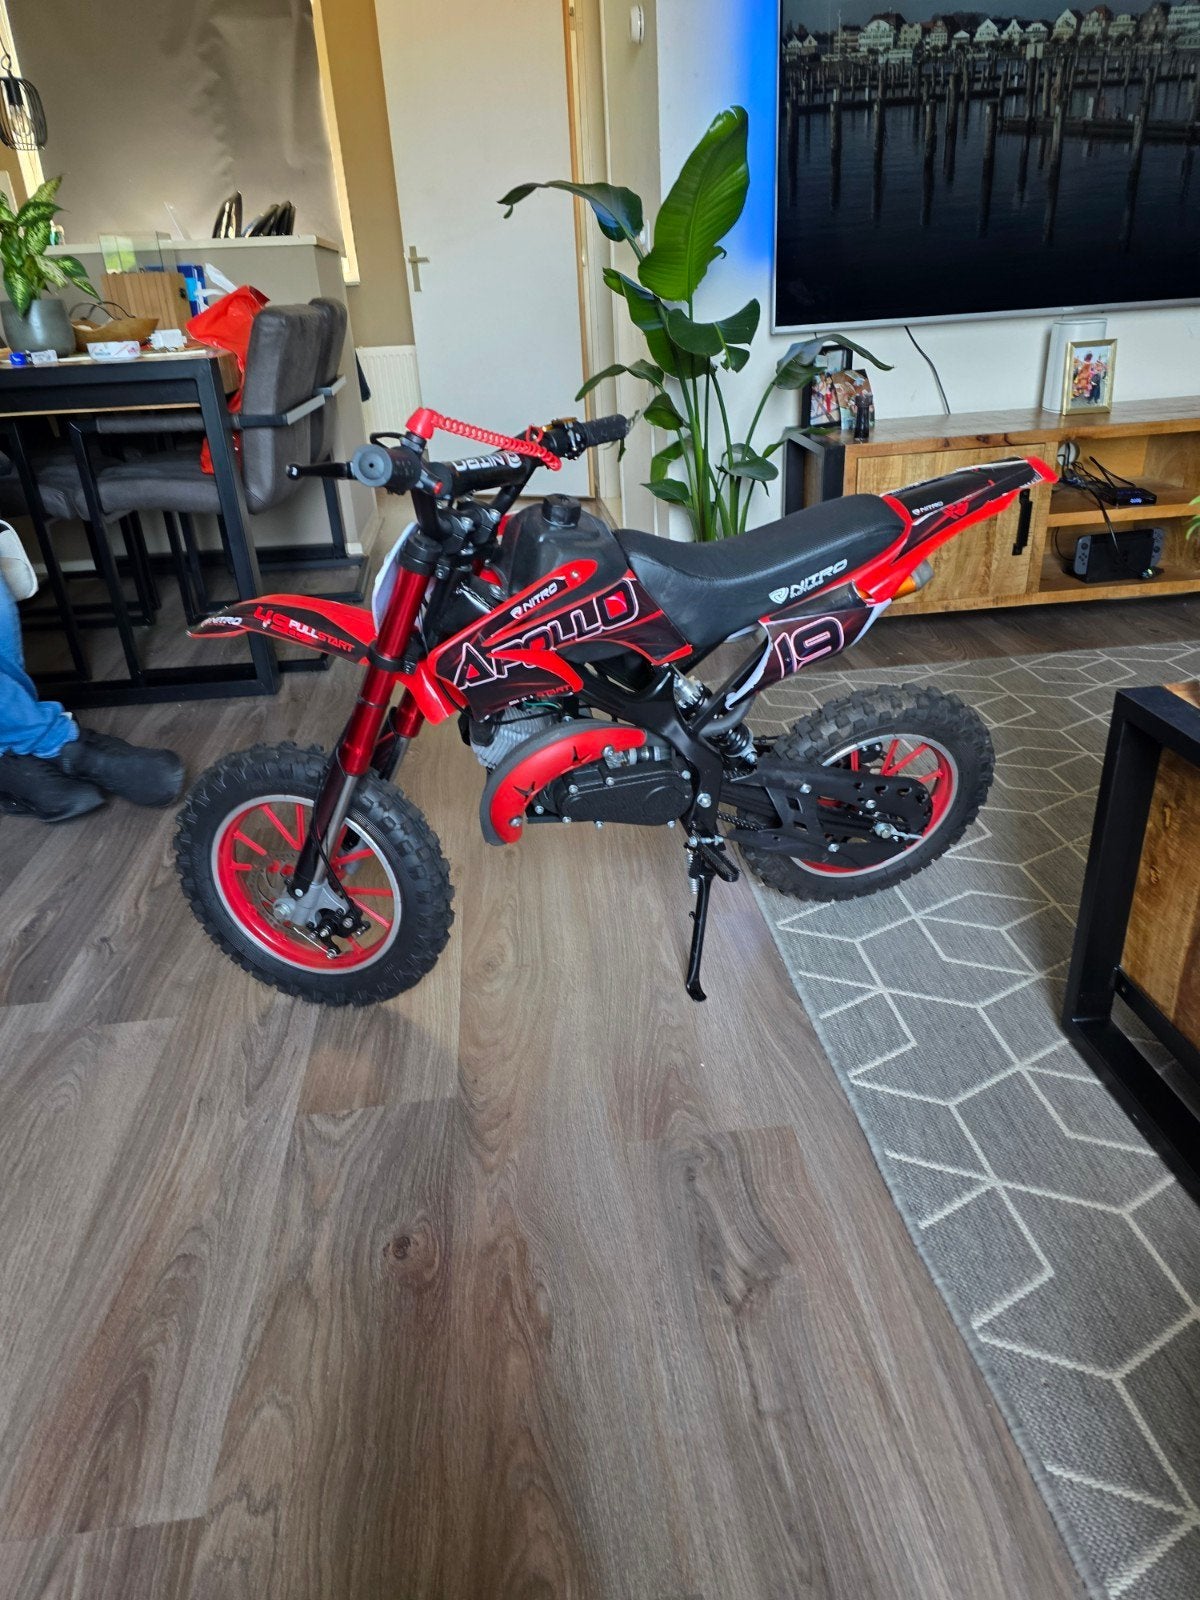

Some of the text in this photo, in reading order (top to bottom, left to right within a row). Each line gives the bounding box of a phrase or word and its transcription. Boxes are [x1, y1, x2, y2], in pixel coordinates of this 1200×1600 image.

[920, 501, 944, 513] NITRO
[790, 558, 848, 599] NITRO
[523, 582, 558, 613] NITRO
[774, 616, 845, 679] 19
